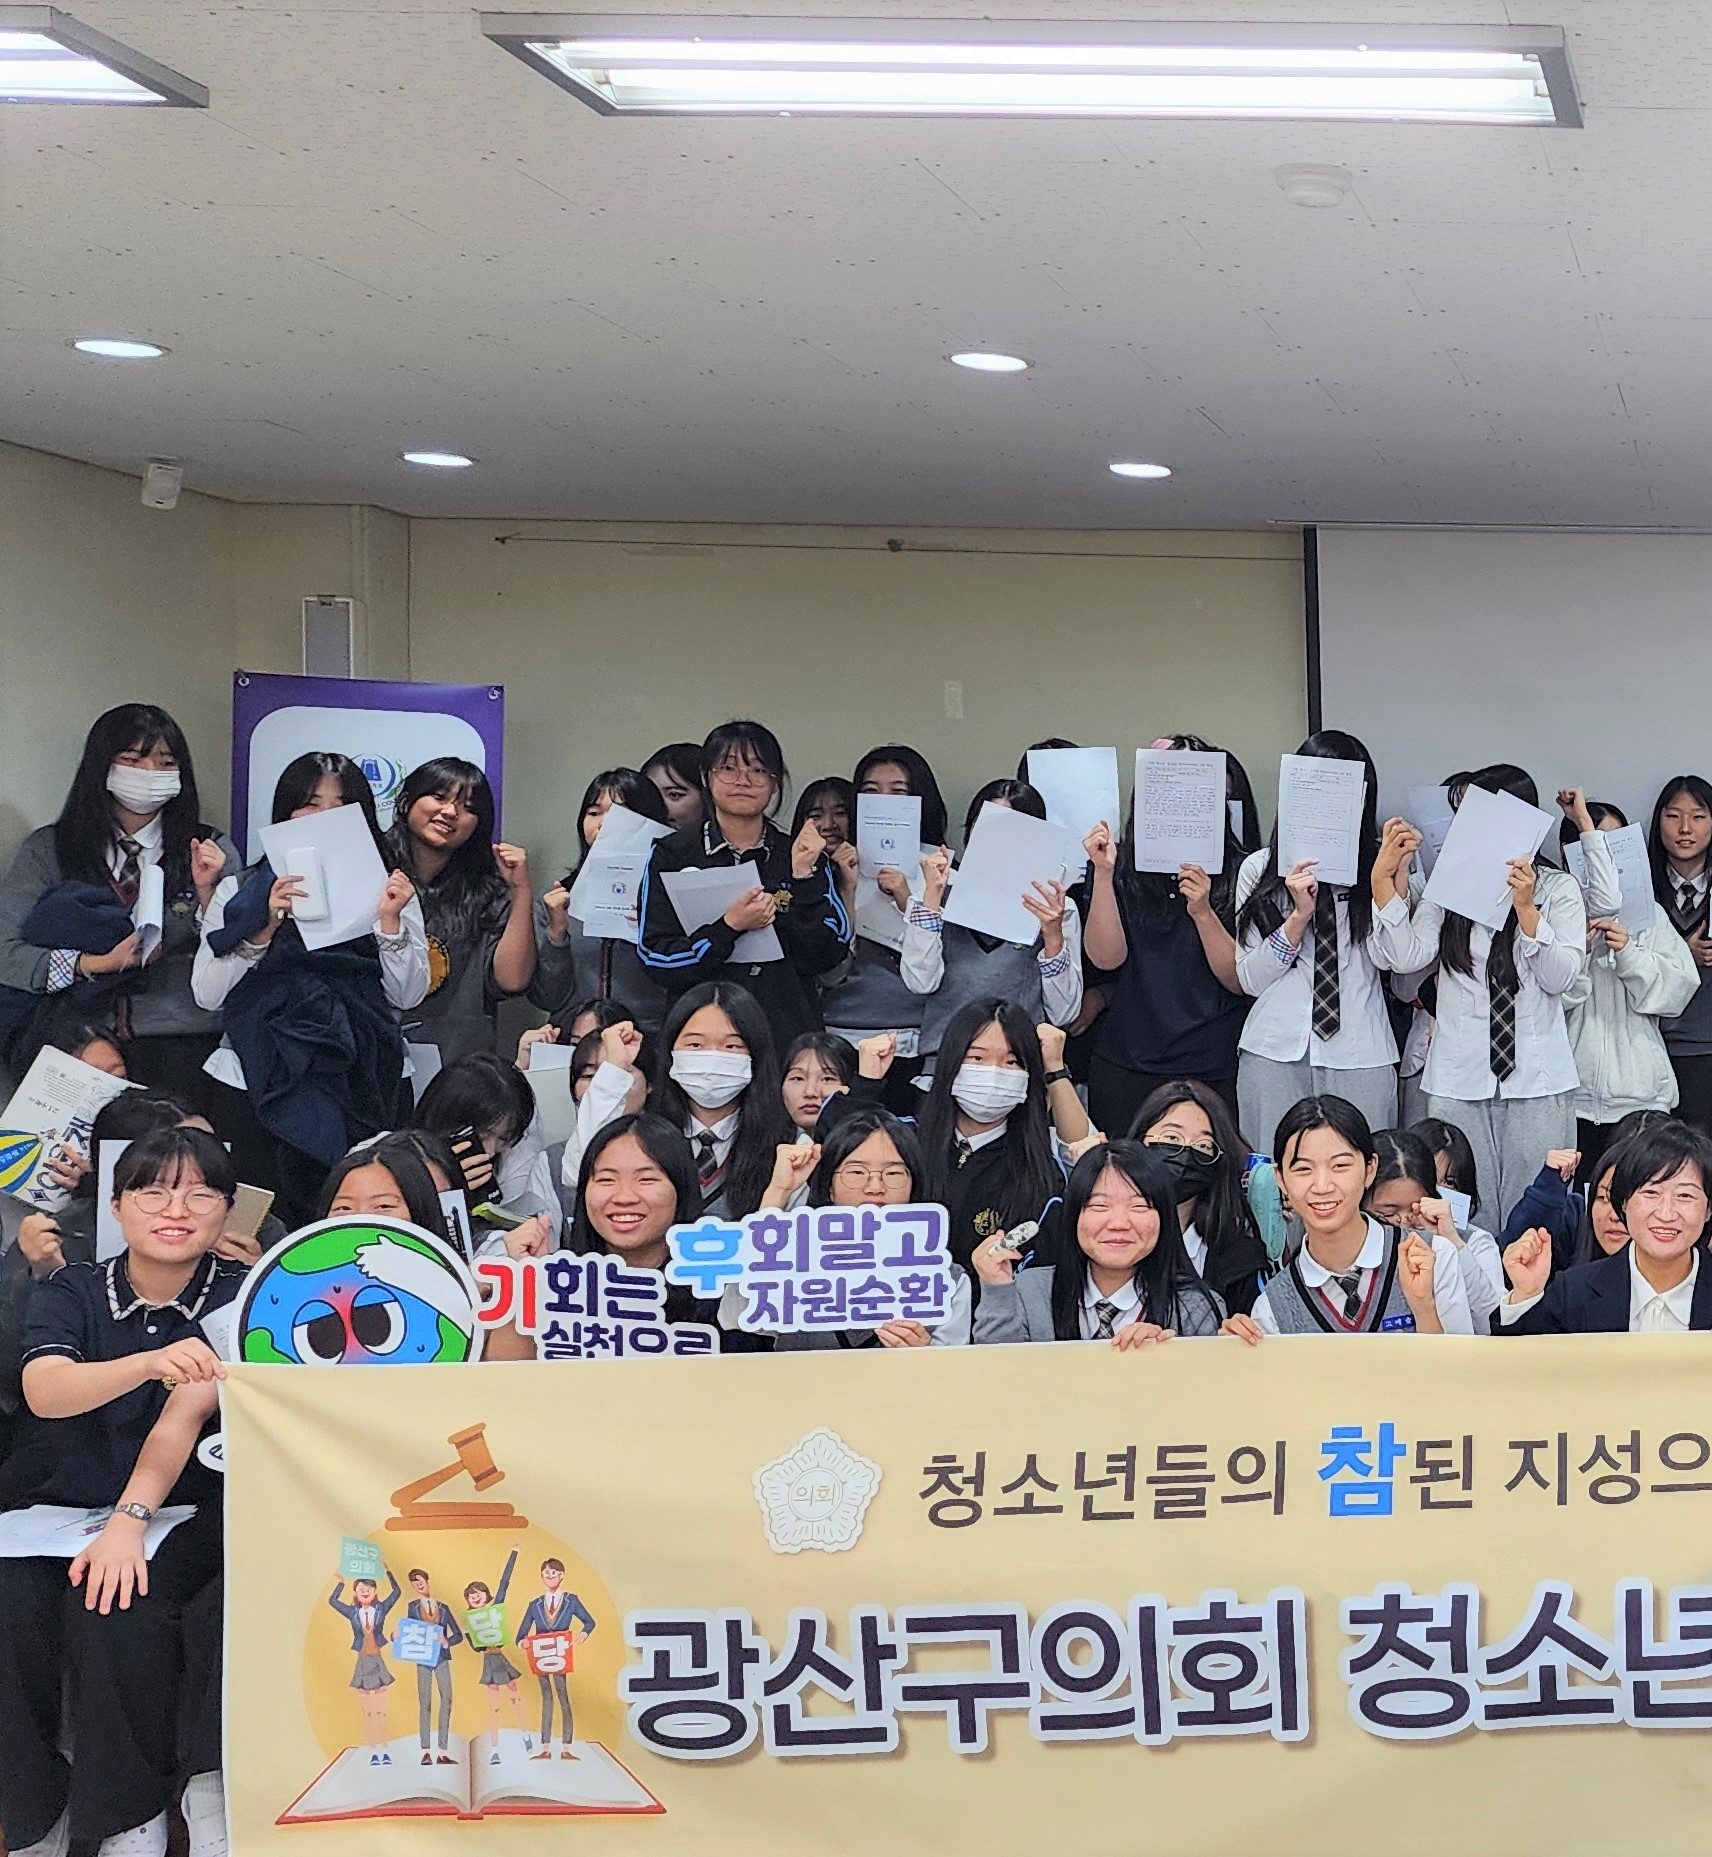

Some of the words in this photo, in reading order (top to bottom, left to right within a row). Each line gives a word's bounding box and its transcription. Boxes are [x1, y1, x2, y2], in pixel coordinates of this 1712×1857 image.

[674, 1211, 944, 1292] 후회말고
[478, 1258, 659, 1328] 기회는
[746, 1273, 949, 1325] 자원순환
[793, 1482, 836, 1507] 의회
[920, 1441, 1286, 1528] 청소년들의
[1317, 1422, 1474, 1517] 참된
[400, 1624, 438, 1655] 참
[467, 1608, 504, 1643] 당
[532, 1636, 571, 1673] 당
[627, 1597, 1295, 1750] 광산구의회
